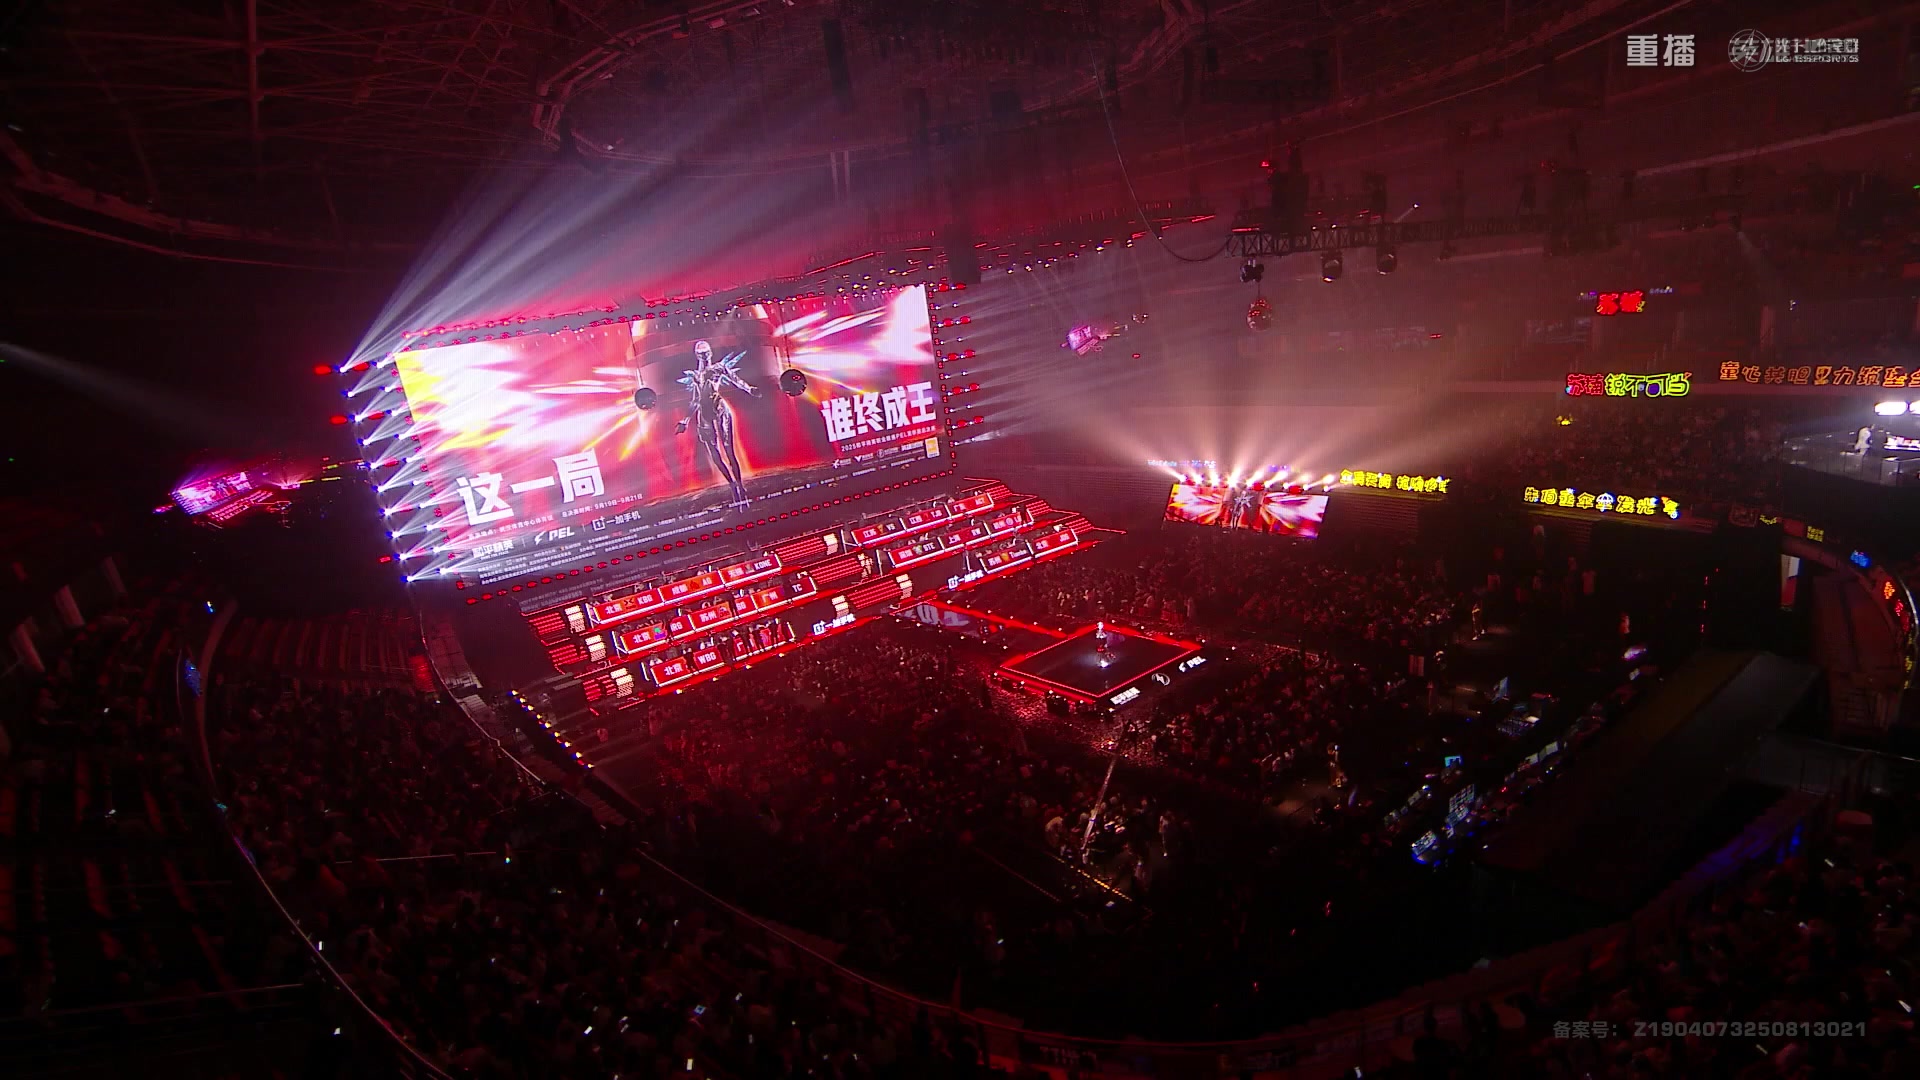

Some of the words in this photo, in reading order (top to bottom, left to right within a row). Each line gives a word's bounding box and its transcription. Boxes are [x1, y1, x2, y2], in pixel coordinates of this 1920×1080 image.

[821, 381, 936, 443] 谁终成王
[455, 447, 605, 526] 这一局
[549, 526, 575, 541] PEL
[605, 603, 622, 615] 北京
[632, 631, 651, 644] 北京
[663, 662, 683, 676] 北京
